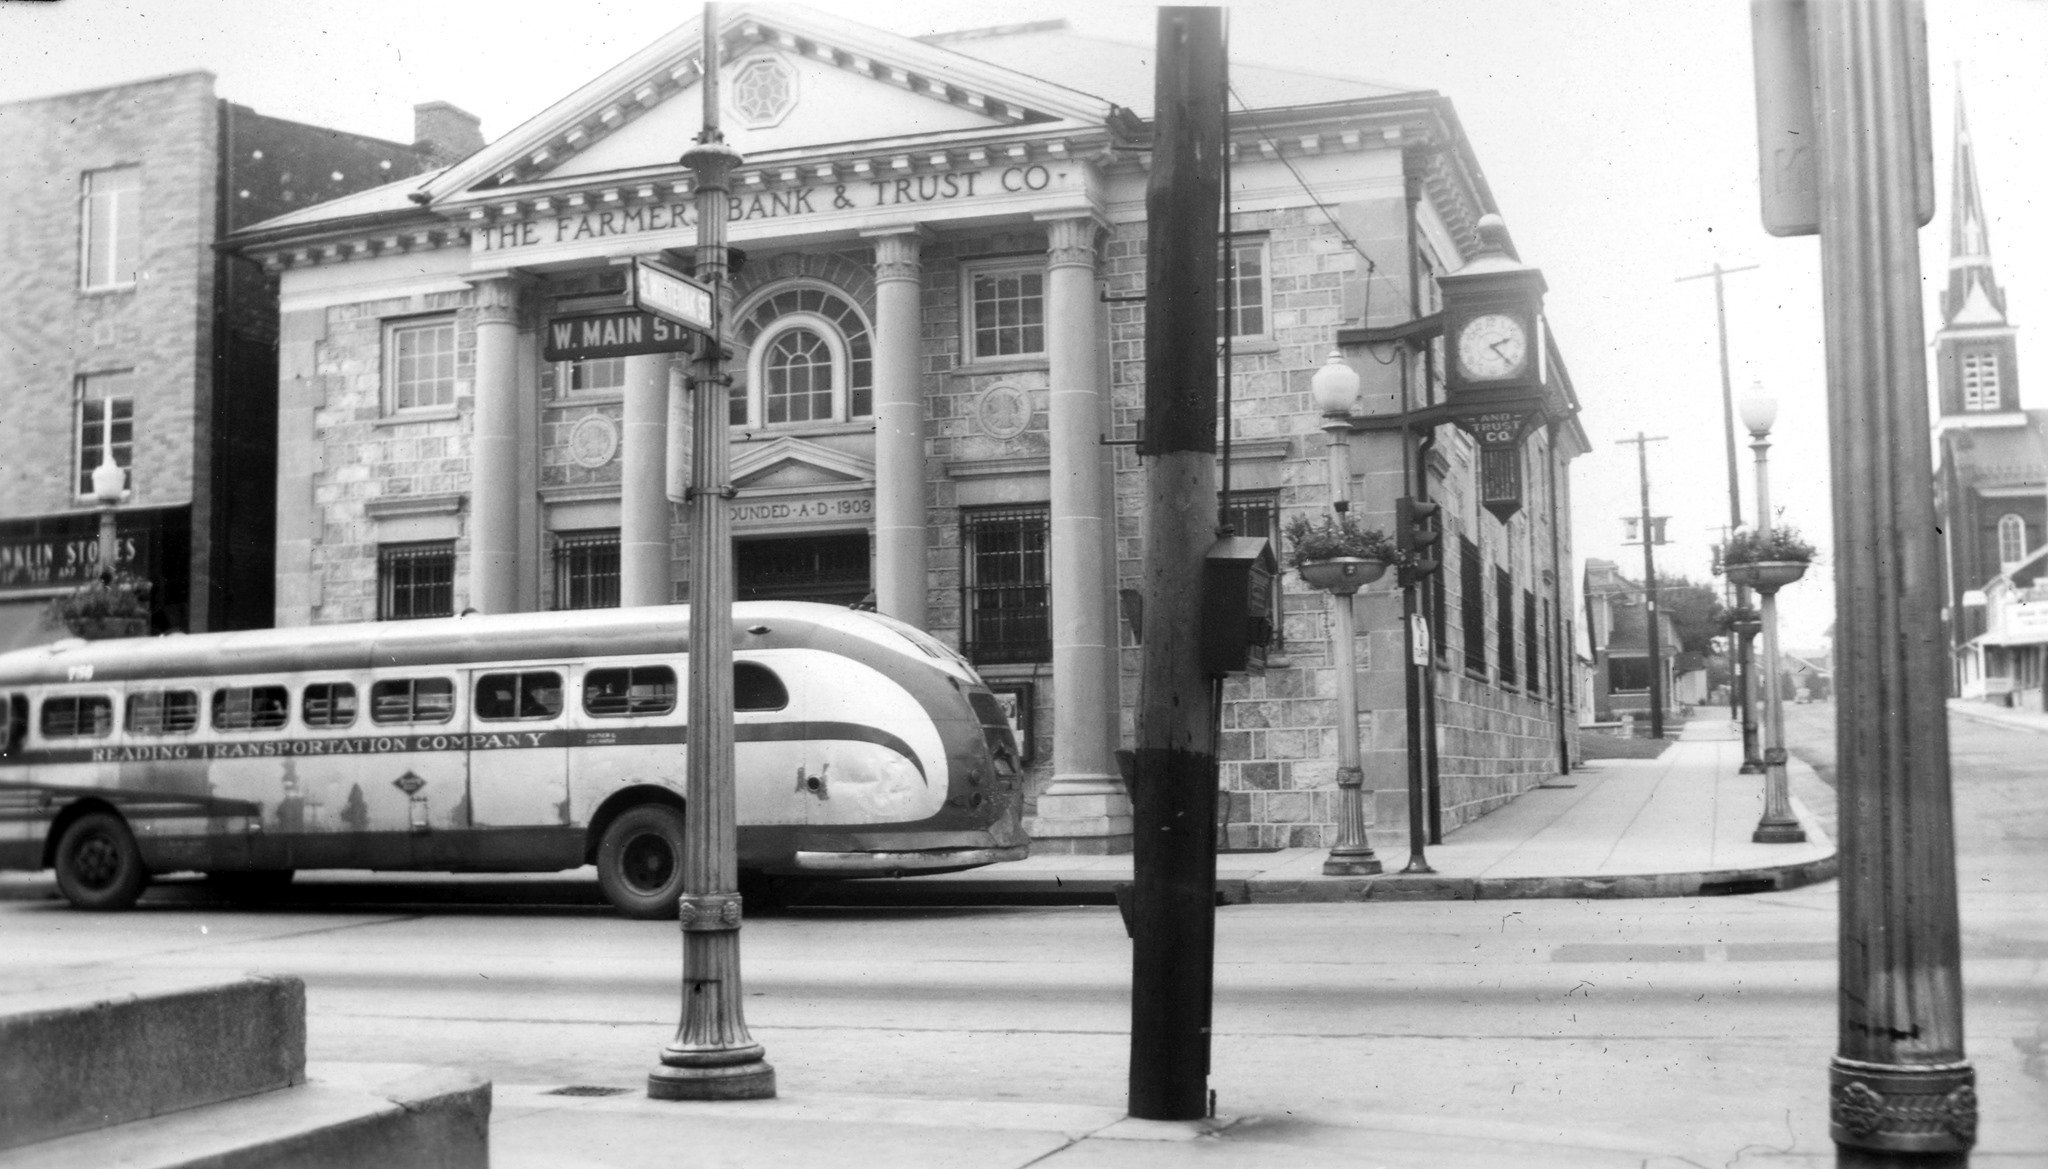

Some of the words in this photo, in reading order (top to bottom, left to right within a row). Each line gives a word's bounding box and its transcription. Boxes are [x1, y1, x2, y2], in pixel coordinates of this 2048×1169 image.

[481, 220, 541, 250] THE
[556, 203, 697, 242] FARMER
[728, 188, 815, 222] BANK
[834, 184, 854, 209] &
[871, 171, 982, 205] TRUST
[553, 323, 577, 350] W.
[583, 316, 643, 347] MAIN
[1471, 420, 1521, 432] TRUST
[1480, 413, 1511, 422] AND
[730, 504, 791, 520] OUNDED
[67, 538, 136, 564] STOES
[91, 744, 188, 761] READING
[201, 737, 407, 759] TRANSPORTATION
[416, 733, 546, 750] COMPANY
